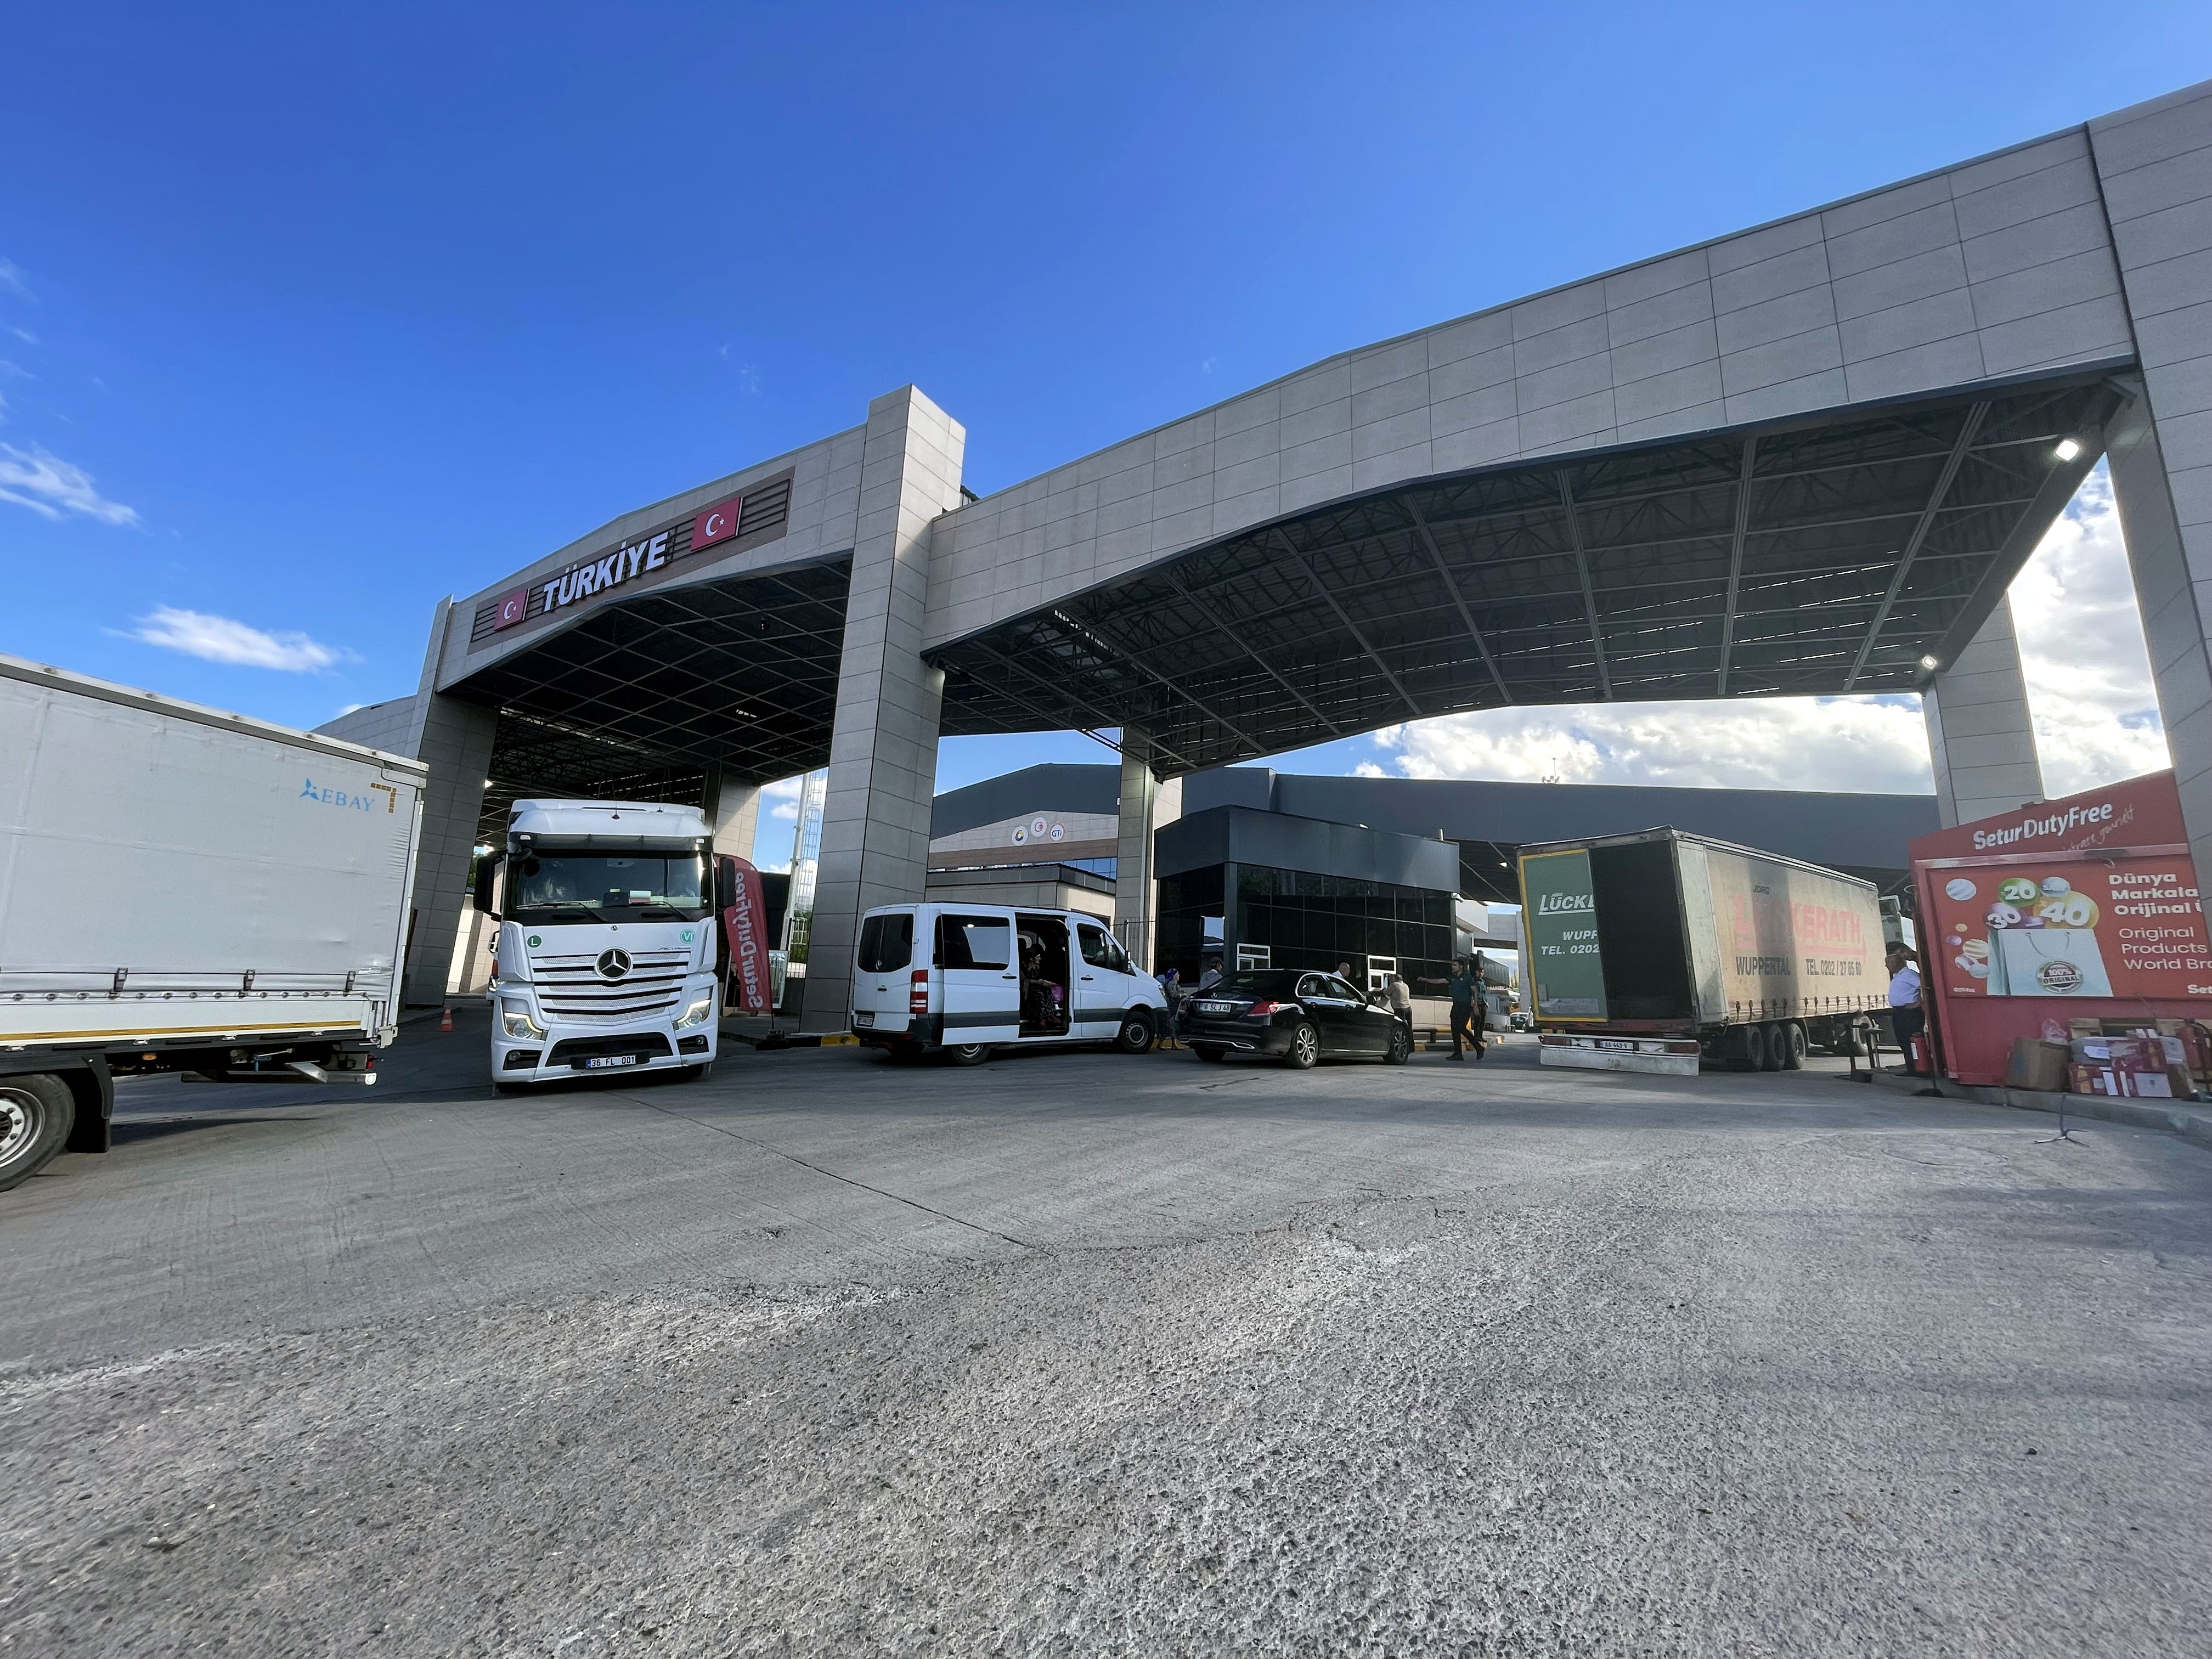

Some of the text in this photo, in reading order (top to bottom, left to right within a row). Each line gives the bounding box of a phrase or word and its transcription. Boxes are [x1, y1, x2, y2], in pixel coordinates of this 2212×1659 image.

[543, 531, 669, 612] TÜRKİYE
[320, 788, 375, 812] EBAY
[1973, 803, 2112, 850] SeturDutyFree
[2109, 873, 2177, 887] Dünya
[2040, 899, 2090, 926] 40
[2114, 902, 2192, 917] Orijinal
[2119, 926, 2194, 941] Original
[531, 938, 538, 946] L
[1541, 944, 1600, 955] TEL. 0202
[2121, 943, 2208, 954] Products
[1735, 956, 1791, 975] WUPPERTAL
[2124, 958, 2182, 969] World
[606, 1058, 615, 1066] FL
[622, 1056, 634, 1064] 001
